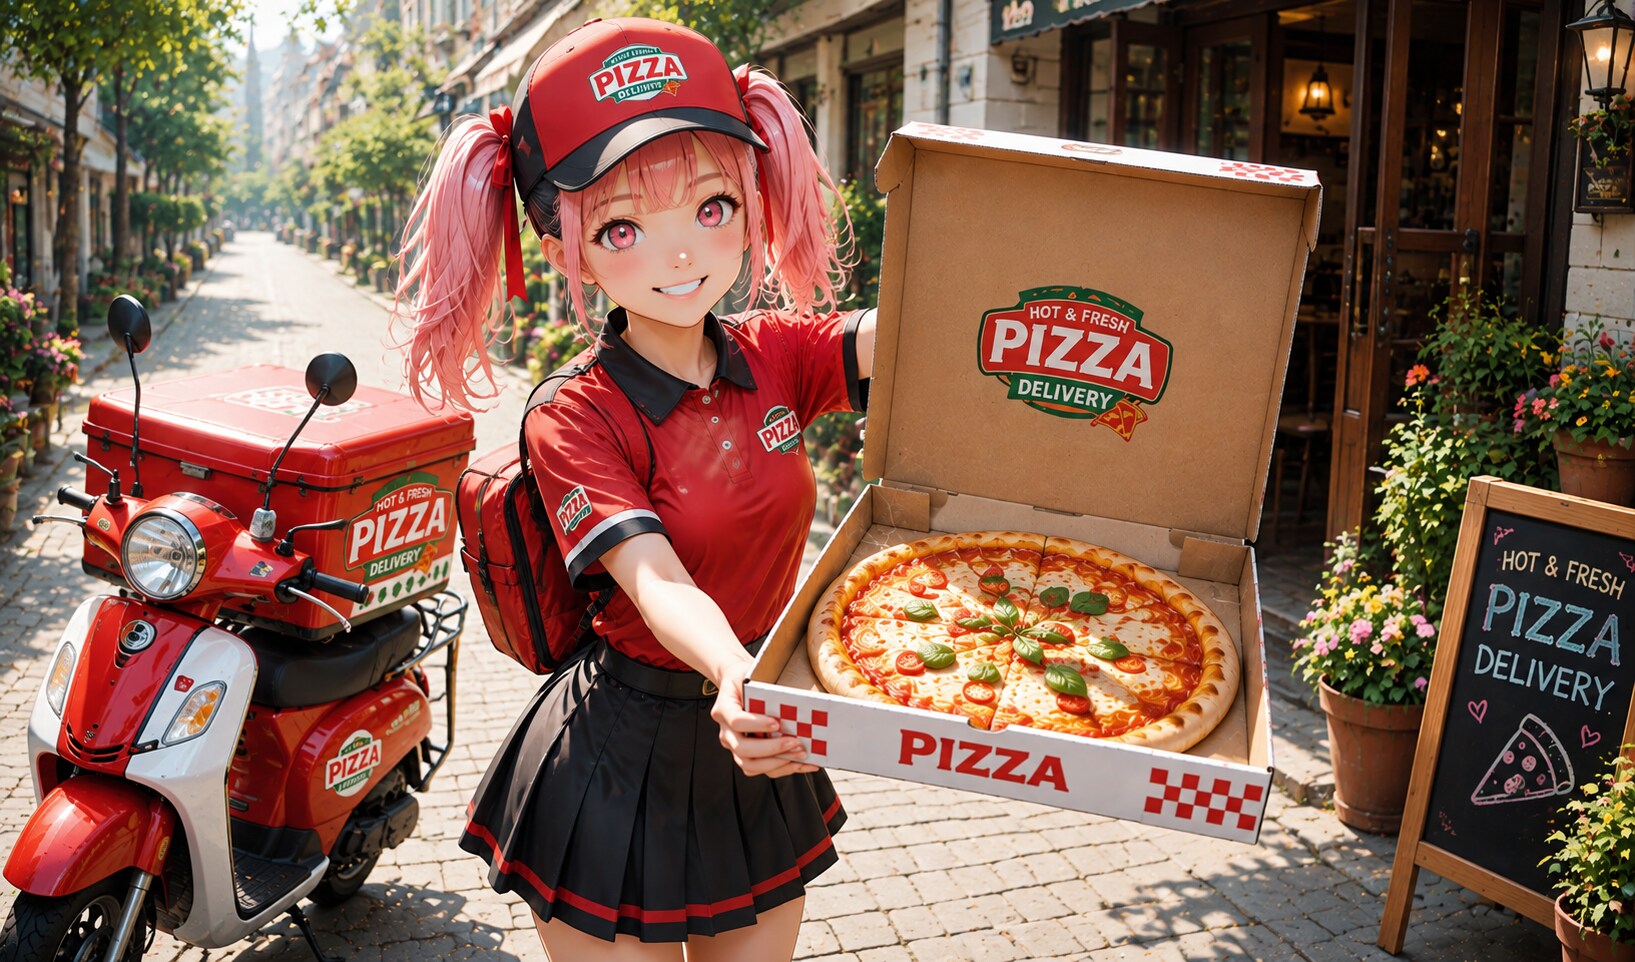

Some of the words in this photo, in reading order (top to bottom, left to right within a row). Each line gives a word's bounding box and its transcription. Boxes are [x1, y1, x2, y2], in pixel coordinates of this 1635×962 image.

[594, 57, 683, 97] PIZZA
[1030, 306, 1061, 319] HOT
[1065, 308, 1077, 321] &
[1081, 309, 1130, 334] FRESH
[989, 319, 1153, 389] PIZZA
[1017, 379, 1113, 410] DELIVERY
[761, 414, 799, 449] PIZZA
[376, 494, 397, 512] HOT
[406, 487, 432, 502] FRESH
[348, 497, 446, 564] PIZZA
[369, 547, 422, 577] DELIVERY
[1502, 550, 1541, 573] HOT
[1545, 555, 1558, 578] &
[1565, 560, 1626, 600] FRESH
[1482, 583, 1621, 667] PIZZA
[1474, 643, 1615, 711] DELIVERY
[329, 744, 379, 785] PIZZA
[898, 729, 1069, 792] PIZZA
